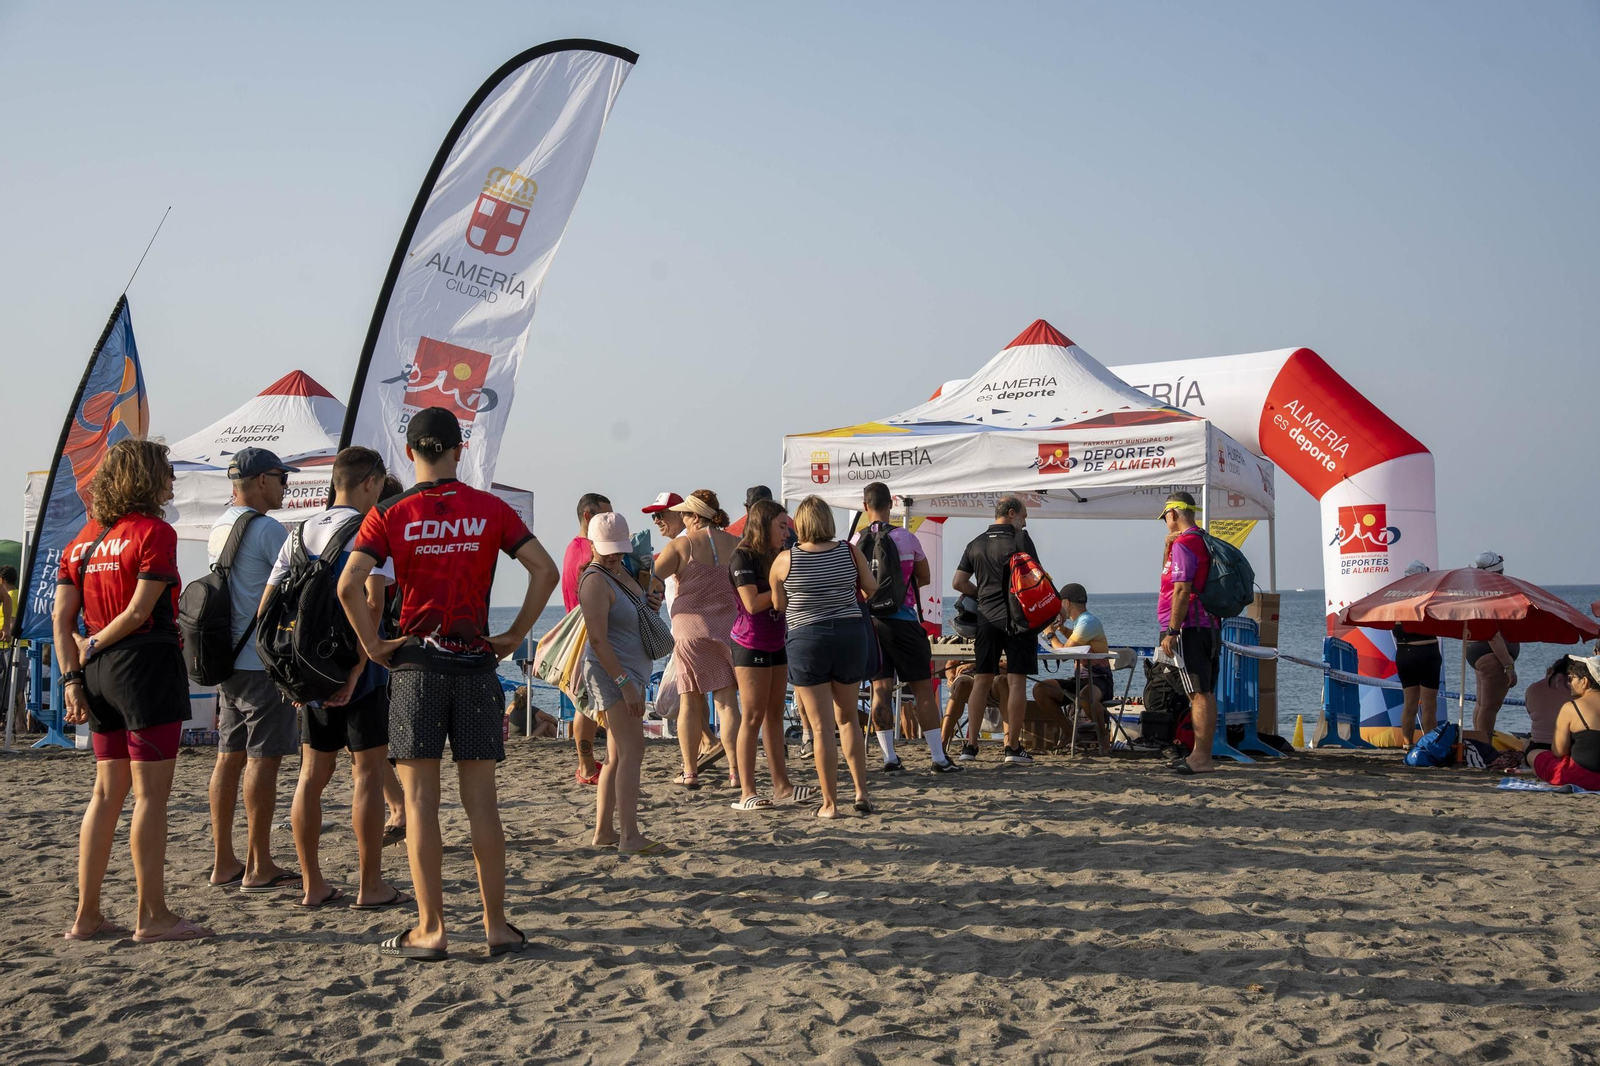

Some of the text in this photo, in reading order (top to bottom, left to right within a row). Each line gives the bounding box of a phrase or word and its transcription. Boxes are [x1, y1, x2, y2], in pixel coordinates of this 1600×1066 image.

[425, 252, 526, 299] ALMERÍA
[445, 278, 498, 303] CIUDAD
[979, 375, 1057, 393] ALMERÍA
[976, 388, 1056, 402] es deporte
[220, 423, 286, 436] ALMERÍA
[1283, 399, 1350, 459] ALMERÍA
[231, 434, 280, 444] deporte
[1083, 438, 1123, 447] PATRONATO
[1125, 437, 1161, 445] MUNICIPAL
[1273, 414, 1337, 473] es deporte
[847, 446, 933, 468] ALMERÍA
[1083, 445, 1166, 461] DEPORTES
[1083, 457, 1177, 472] DE ALMERIA
[847, 469, 891, 481] CIUDAD
[283, 487, 331, 498] PORTES
[403, 517, 487, 542] CDNW
[414, 542, 480, 555] ROQUETAS
[1341, 558, 1389, 567] DEPORTES
[1352, 566, 1390, 574] ALMERIA
